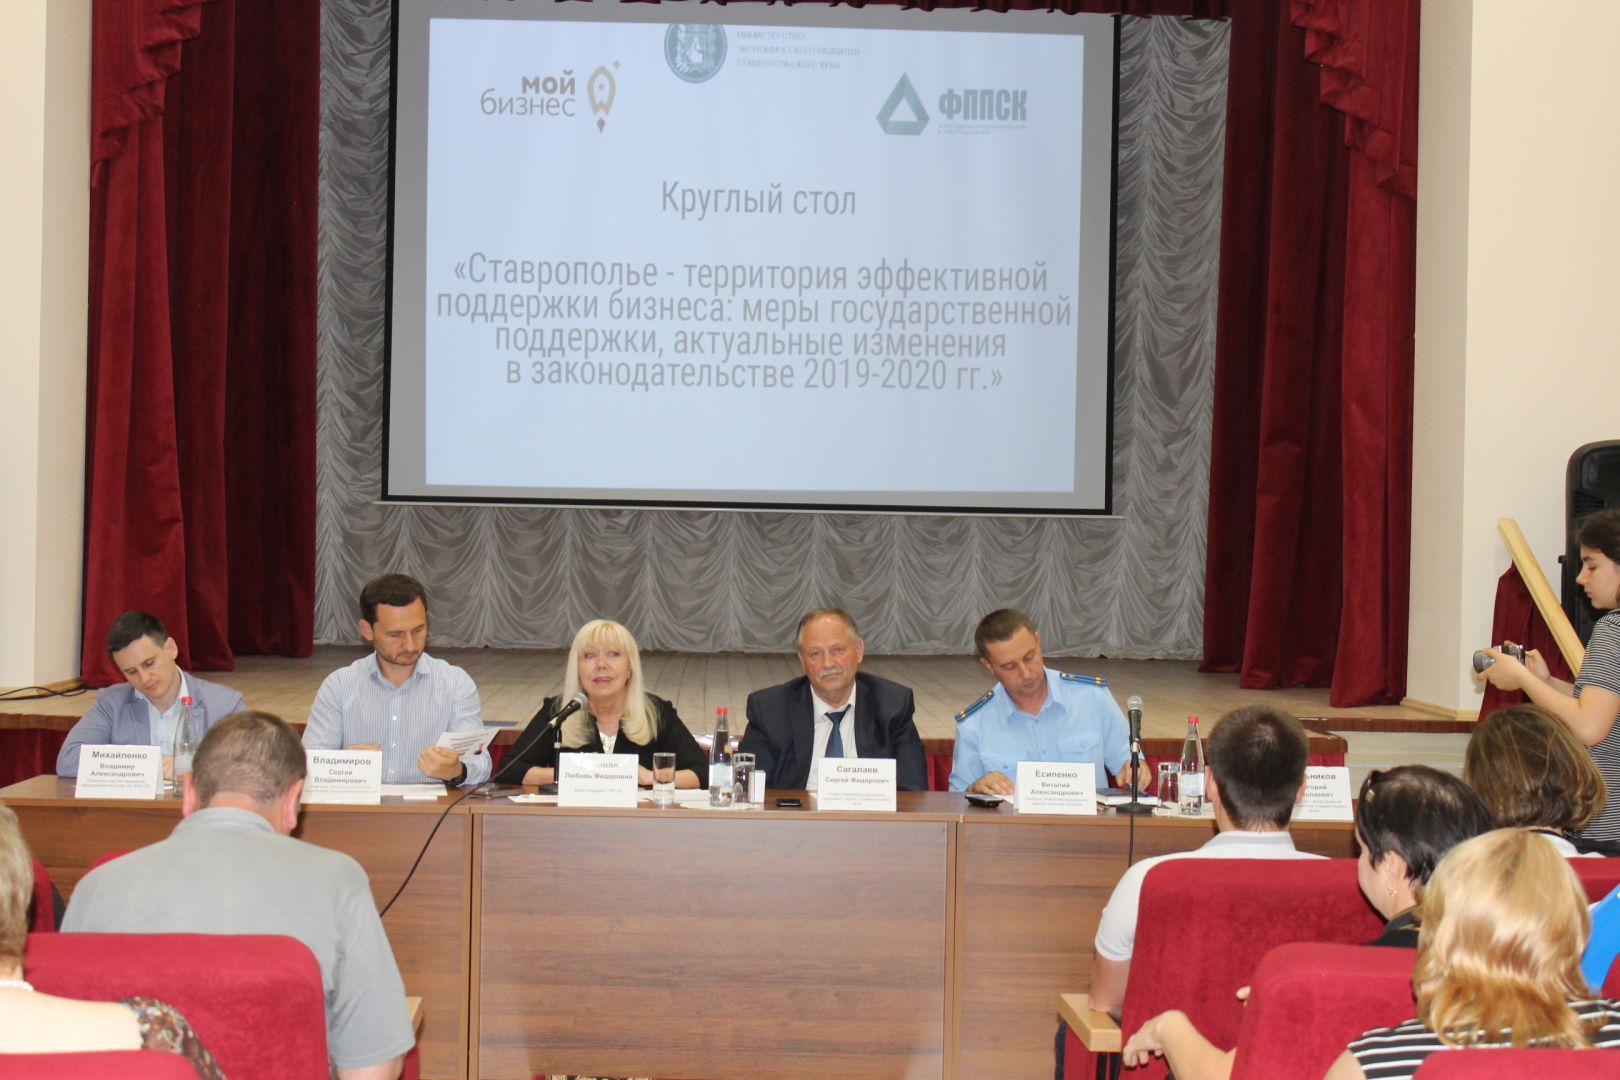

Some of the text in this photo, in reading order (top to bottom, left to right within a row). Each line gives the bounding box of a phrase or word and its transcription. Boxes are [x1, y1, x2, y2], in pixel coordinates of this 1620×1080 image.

[521, 69, 576, 95] мой
[480, 88, 576, 117] бизнес
[938, 88, 1028, 121] ФППСК
[662, 180, 856, 222] Круглый стол
[454, 252, 658, 293] «Ставрополье
[683, 263, 847, 297] территория
[857, 257, 1047, 299] эффективной
[437, 287, 1070, 332] поддержки бизнеса: меры государственной
[495, 326, 1006, 364] поддержки, актуальные изменения
[506, 358, 1003, 392] в законодательстве 2019-2020 гг.»
[91, 751, 148, 760] Михайленко
[313, 756, 372, 767] Владимиров
[90, 770, 145, 778] Александрович
[99, 763, 136, 771] Владимир
[836, 765, 878, 774] Сагалаев
[1035, 770, 1078, 779] Есипенко
[825, 776, 890, 785] Сергей Федорович
[1030, 788, 1084, 797] Александрович
